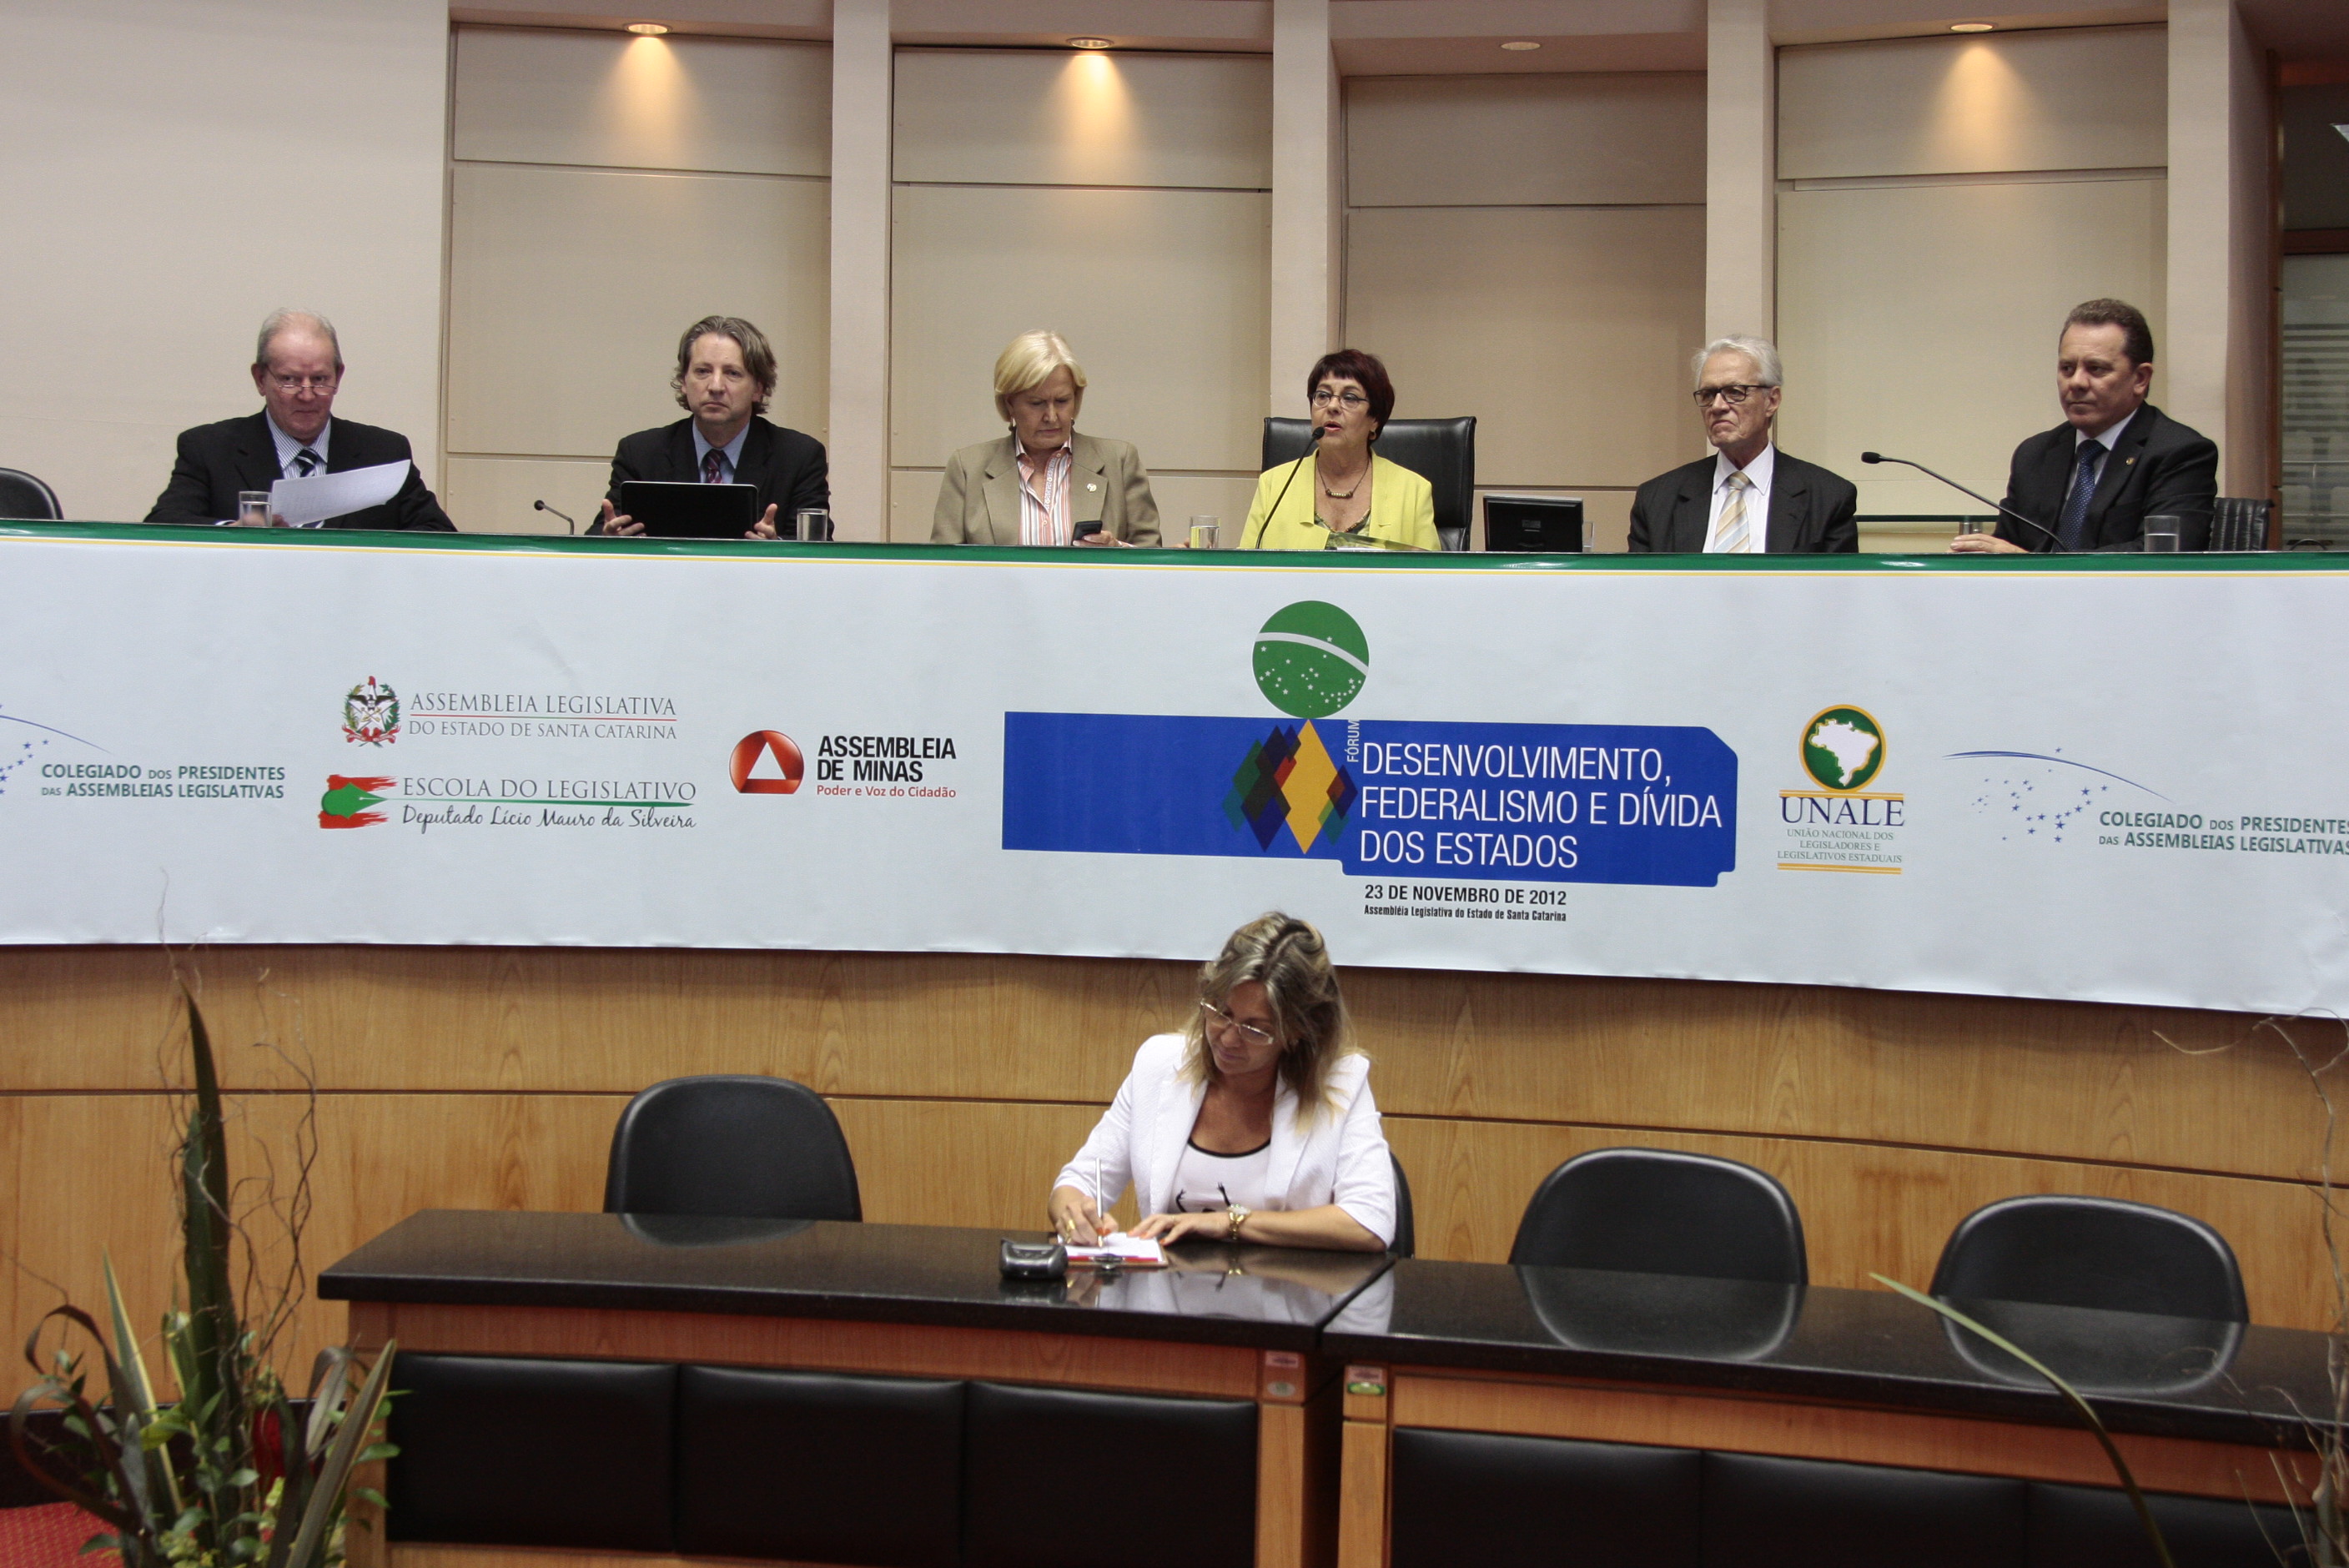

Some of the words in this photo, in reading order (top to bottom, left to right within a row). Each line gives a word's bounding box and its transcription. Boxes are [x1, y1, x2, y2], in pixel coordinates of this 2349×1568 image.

[410, 692, 539, 713] ASSEMBLEIA
[546, 695, 677, 716] LEGISLATIVA
[408, 720, 435, 736] DO
[440, 721, 505, 736] ESTADO
[511, 722, 531, 737] DE
[537, 722, 591, 738] SANTA
[594, 724, 677, 740] CATARINA
[1344, 719, 1360, 762] FÓRUM
[817, 735, 957, 760] ASSEMBLEIA
[41, 763, 142, 780] COLEGIADO
[148, 769, 173, 780] DOS
[178, 765, 285, 781] PRESIDENTES
[817, 759, 844, 781] DE
[853, 760, 923, 783] MINAS
[1362, 742, 1671, 787] DESENVOLVIMENTO,
[40, 787, 62, 797] DAS
[66, 782, 174, 798] ASSEMBLEIAS
[178, 783, 284, 799] LEGISLATIVAS
[403, 777, 492, 797] ESCOLA
[500, 779, 538, 798] DO
[546, 780, 697, 801] LEGISLATIVO
[817, 784, 853, 797] Poder
[854, 787, 863, 797] e
[864, 785, 887, 797] Voz
[888, 785, 905, 797] do
[908, 786, 957, 798] Cidadão
[1361, 786, 1578, 825] FEDERALISMO
[1589, 792, 1607, 825] E
[1618, 787, 1723, 828] DÍVIDA
[1778, 797, 1906, 827] UNALE
[402, 804, 484, 835] Deputado
[490, 805, 532, 827] Lício
[536, 807, 596, 828] Mauro
[601, 807, 624, 828] da
[628, 807, 697, 829] Silveira
[2099, 811, 2202, 830] COLEGIADO
[2209, 819, 2234, 831] DOS
[2240, 816, 2349, 835] PRESIDENTE
[1787, 827, 1819, 838] UNIÃO
[1822, 830, 1870, 840] NACIONAL
[1874, 832, 1894, 841] DOS
[1799, 840, 1871, 851] LEGISLADORES
[1874, 842, 1880, 852] E
[2098, 835, 2119, 846] DAS
[2124, 832, 2235, 851] ASSEMBLEIAS
[1360, 830, 1425, 864] DOS
[1436, 832, 1578, 869] ESTADOS
[1777, 851, 1846, 861] LEGISLATIVOS
[1849, 853, 1902, 863] ESTADUAIS
[1365, 884, 1383, 899] 23
[1388, 885, 1408, 900] DE
[1413, 886, 1499, 903] NOVEMBRO
[1504, 888, 1525, 904] DE
[1529, 890, 1567, 906] 2012
[1364, 904, 1409, 916] Assembléia
[1411, 905, 1452, 918] Legislativa
[1455, 907, 1465, 918] do
[1467, 907, 1492, 919] Estado
[1495, 909, 1505, 919] de
[1506, 909, 1529, 921] Santa
[1532, 910, 1567, 922] Catarina
